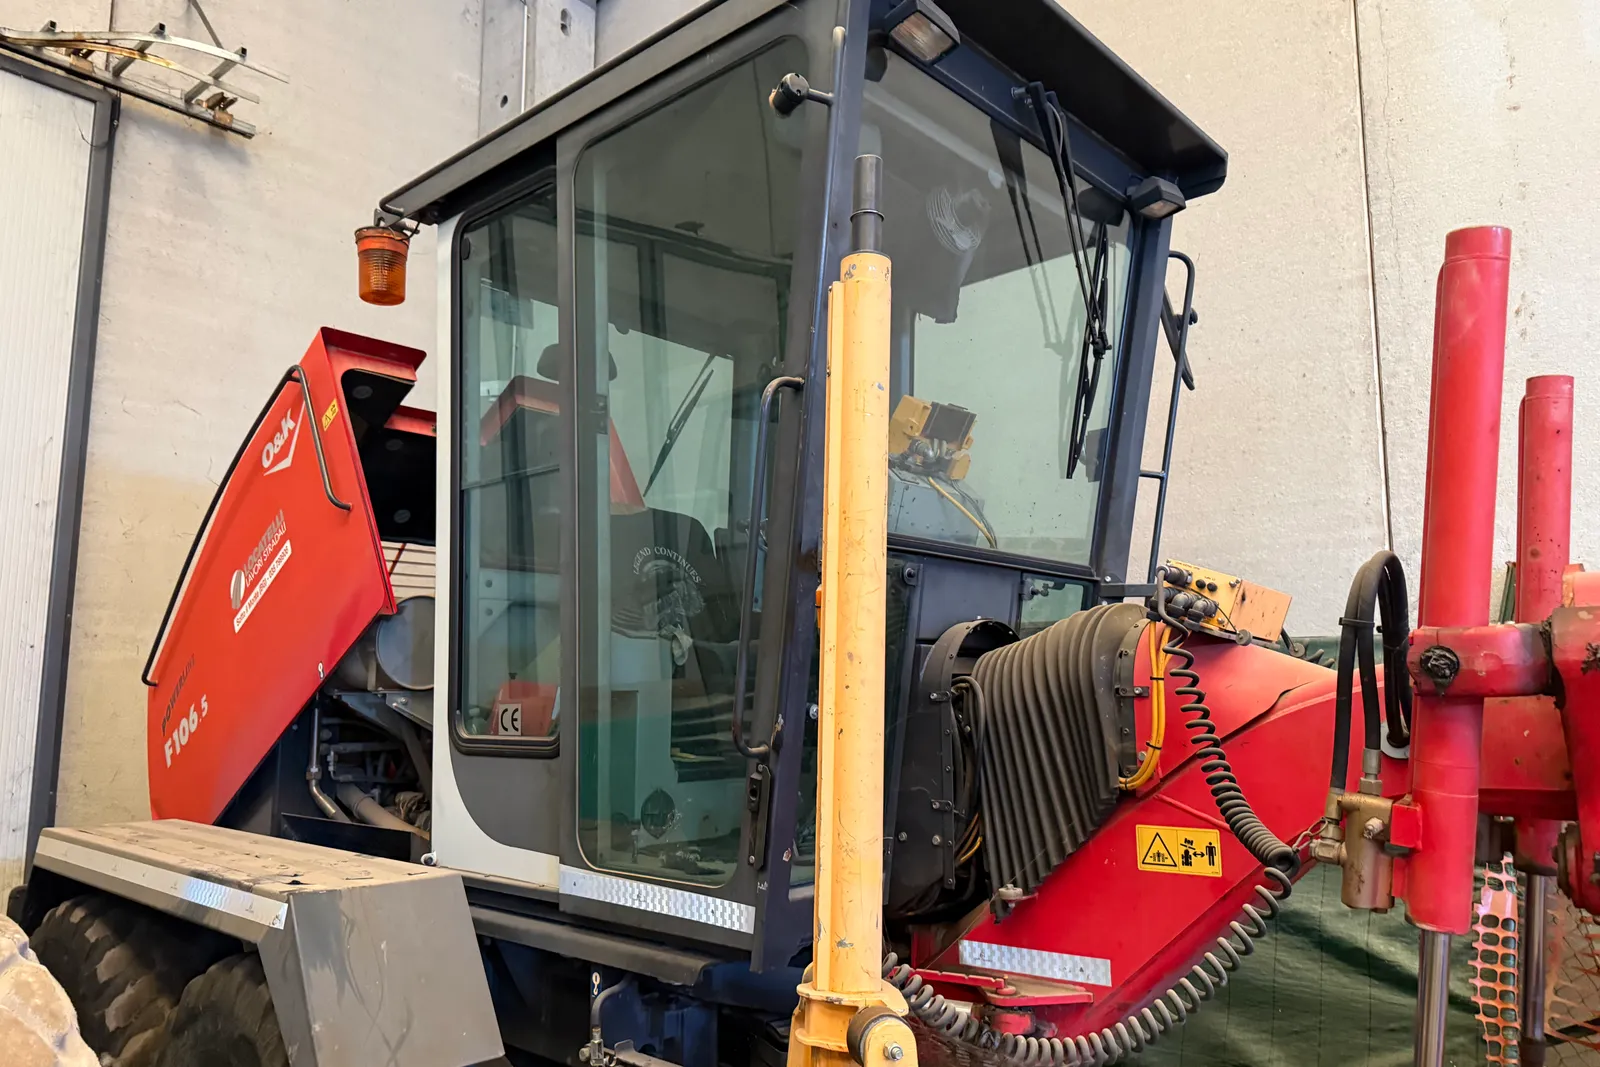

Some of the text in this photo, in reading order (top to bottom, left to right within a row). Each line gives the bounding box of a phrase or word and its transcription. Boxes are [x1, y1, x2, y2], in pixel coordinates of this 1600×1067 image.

[262, 408, 296, 468] O&K
[243, 509, 285, 578] LOCATELLI
[245, 556, 264, 588] LAVORI
[263, 521, 287, 561] STRADALI
[654, 546, 702, 583] CONTINUES
[500, 707, 519, 732] CE
